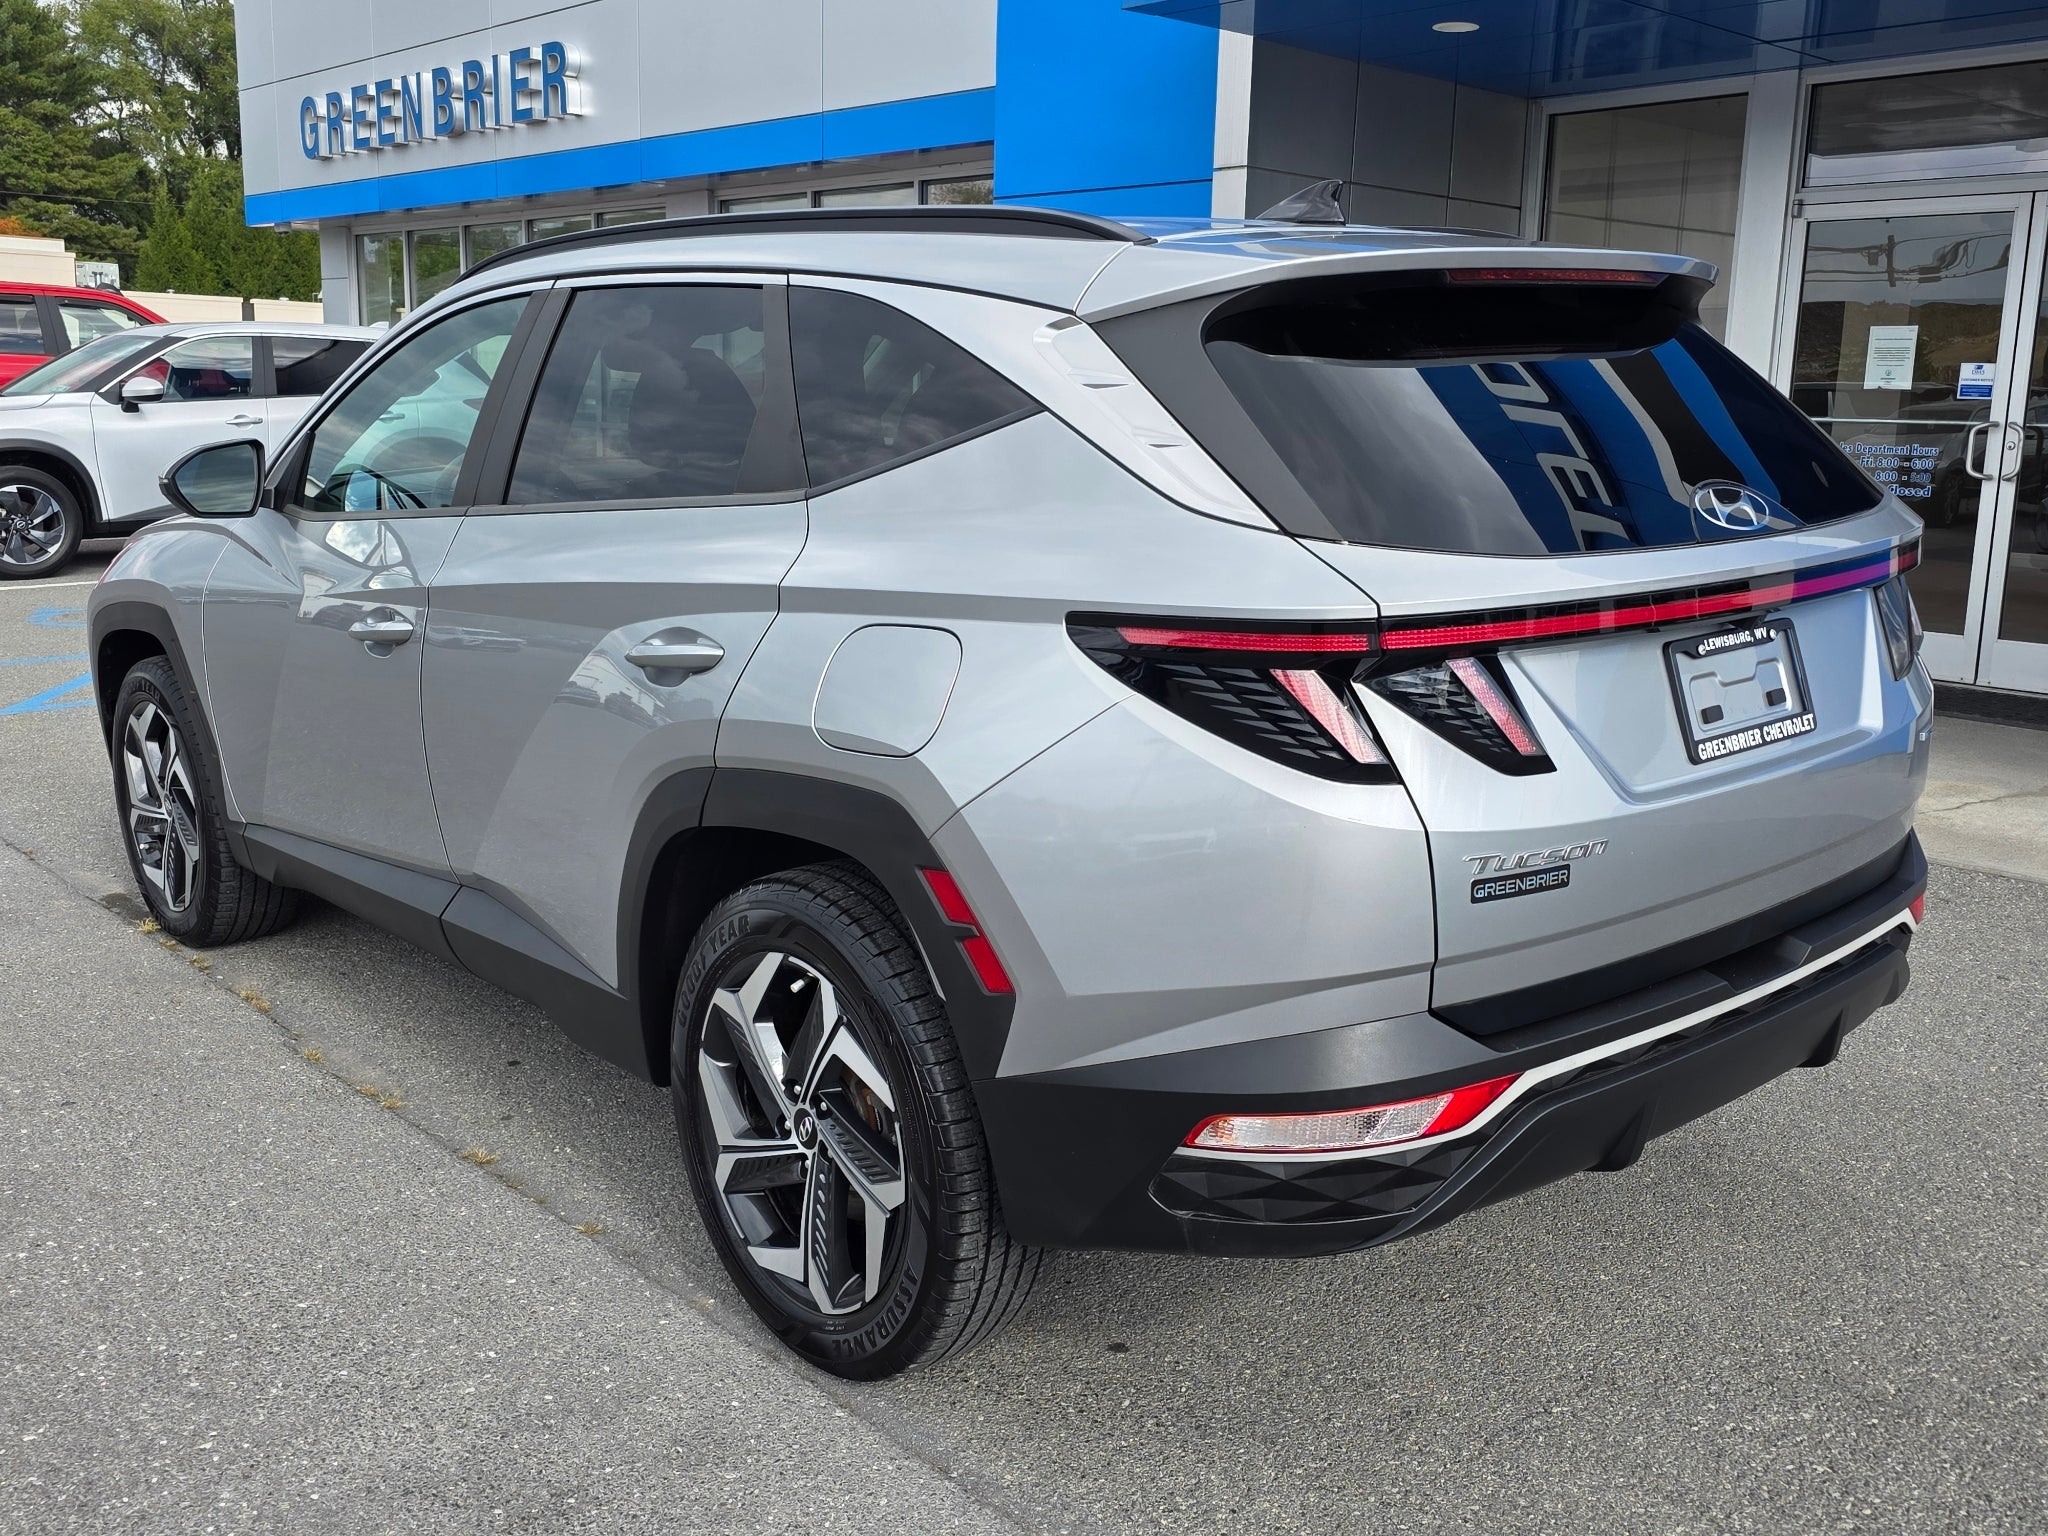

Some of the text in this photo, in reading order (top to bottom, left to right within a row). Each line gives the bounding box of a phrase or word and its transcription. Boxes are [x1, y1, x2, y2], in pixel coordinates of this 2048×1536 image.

[300, 41, 580, 160] GREENBRIER
[1855, 442, 1909, 457] Department
[1911, 444, 1939, 456] Hours
[1860, 456, 1875, 467] Fri.
[1877, 457, 1899, 468] 8:00
[1911, 458, 1934, 469] 6:00
[1875, 471, 1898, 481] 8:00
[1704, 627, 1767, 651] LEWISBURG, WV
[1698, 713, 1815, 760] GREENBRIER CHEVROLET
[1473, 869, 1569, 898] GREENBRIER
[831, 1260, 919, 1358] ASSURANCE
